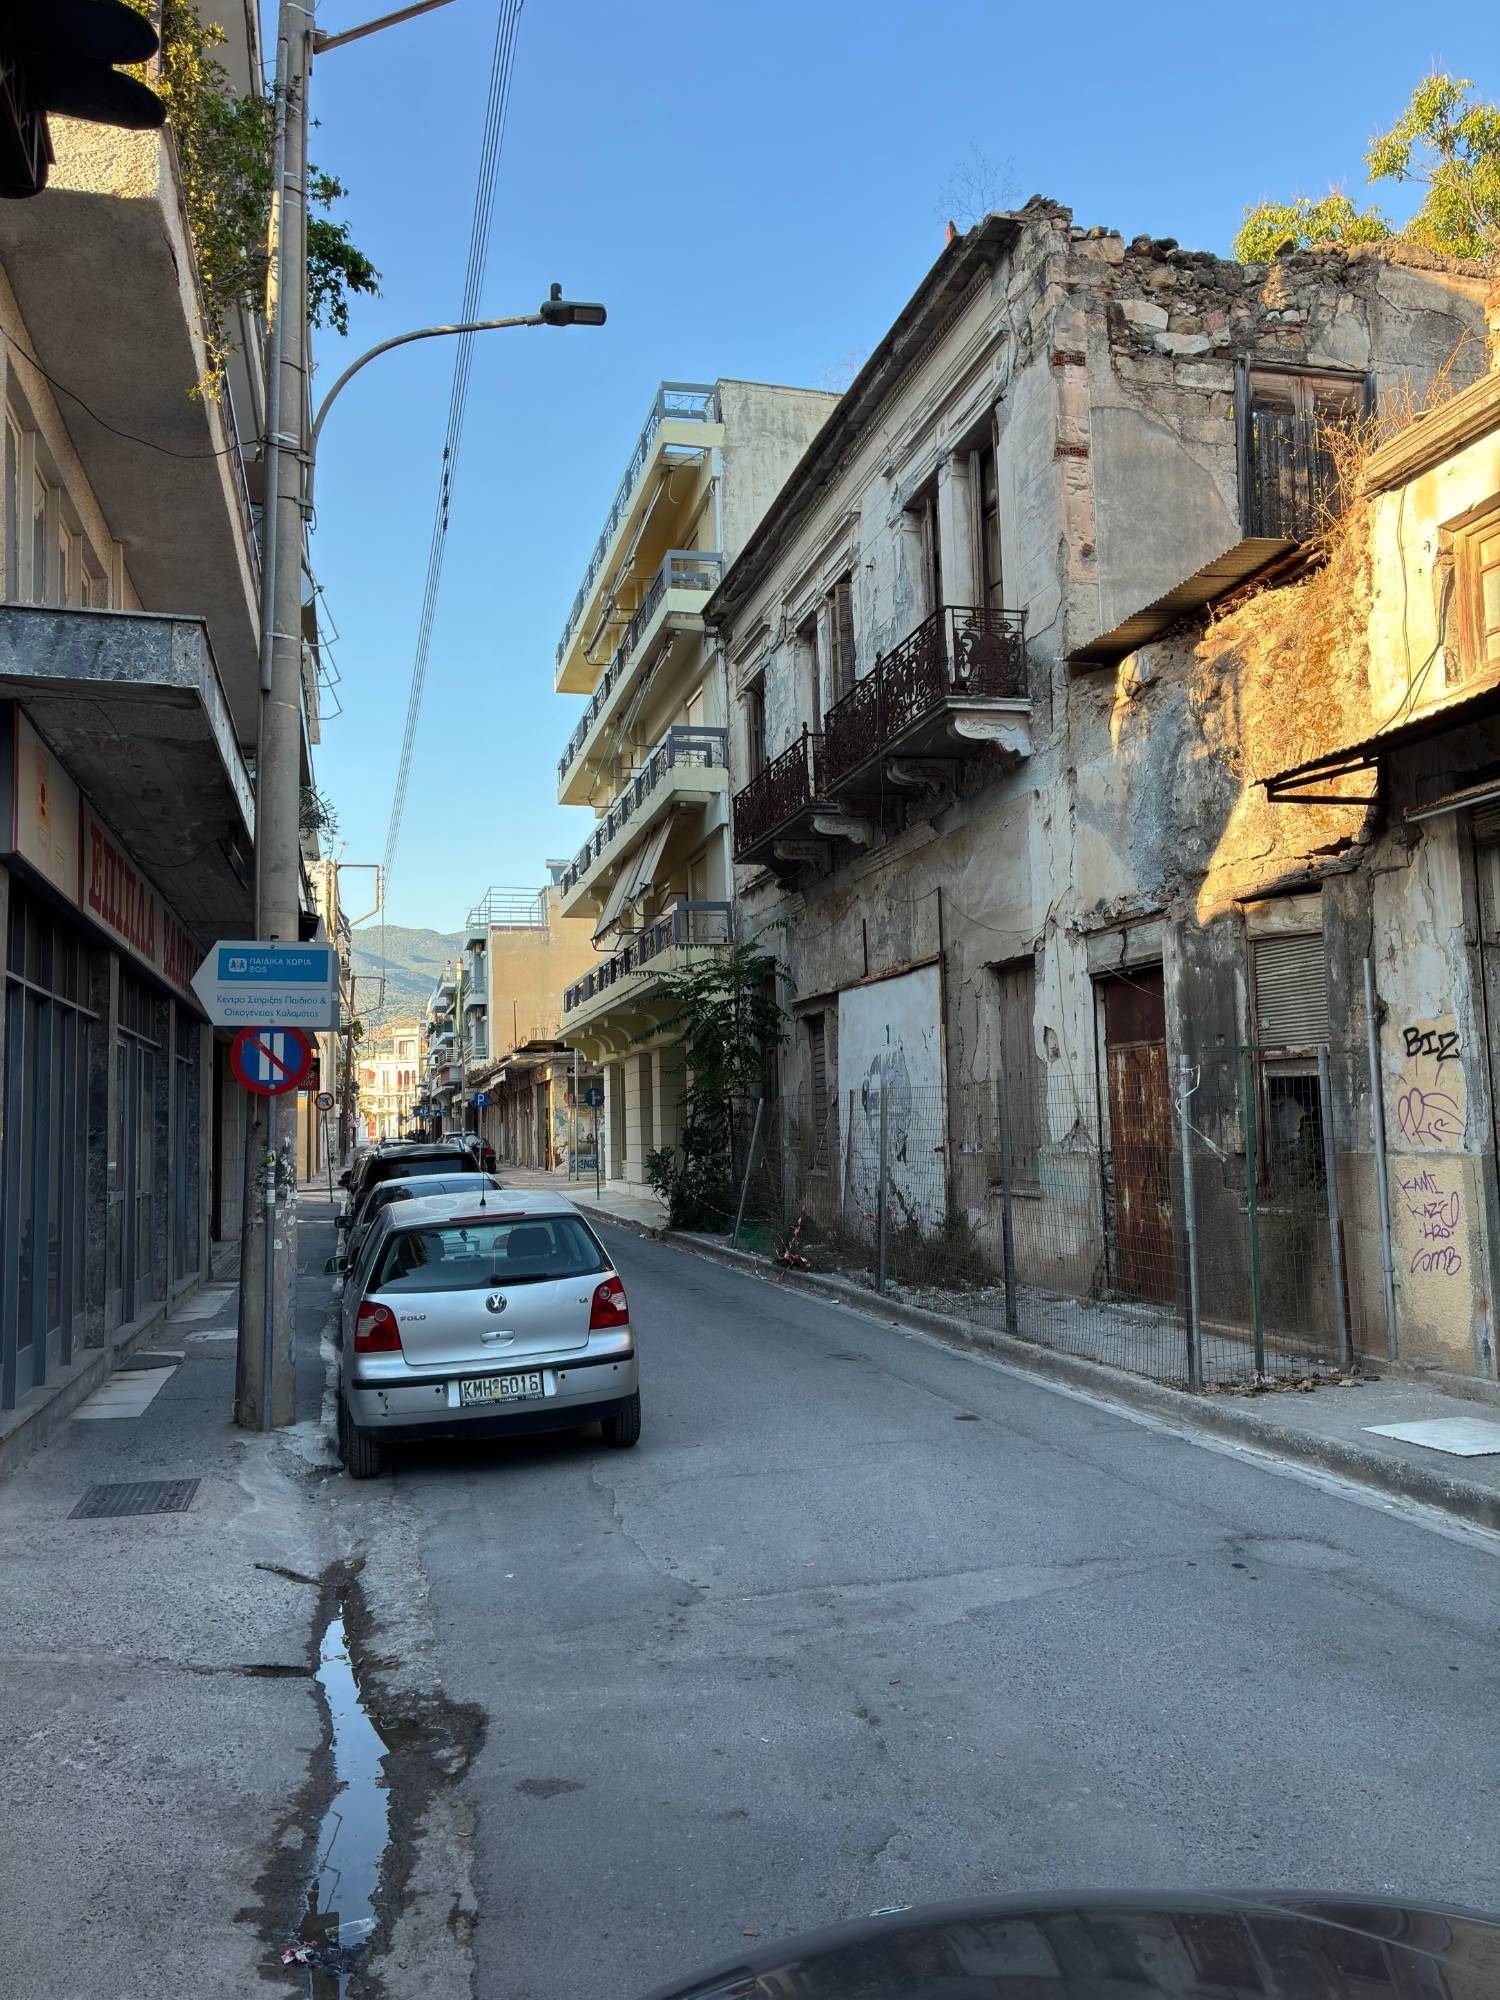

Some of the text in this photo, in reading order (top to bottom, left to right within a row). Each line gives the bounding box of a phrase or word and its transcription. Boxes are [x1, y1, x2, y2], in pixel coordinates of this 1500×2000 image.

[249, 957, 312, 966] ΠΑΙΔΙΚΑ ΧΩΡΙΑ
[1403, 1026, 1461, 1062] BIZ
[399, 1314, 427, 1322] POLO
